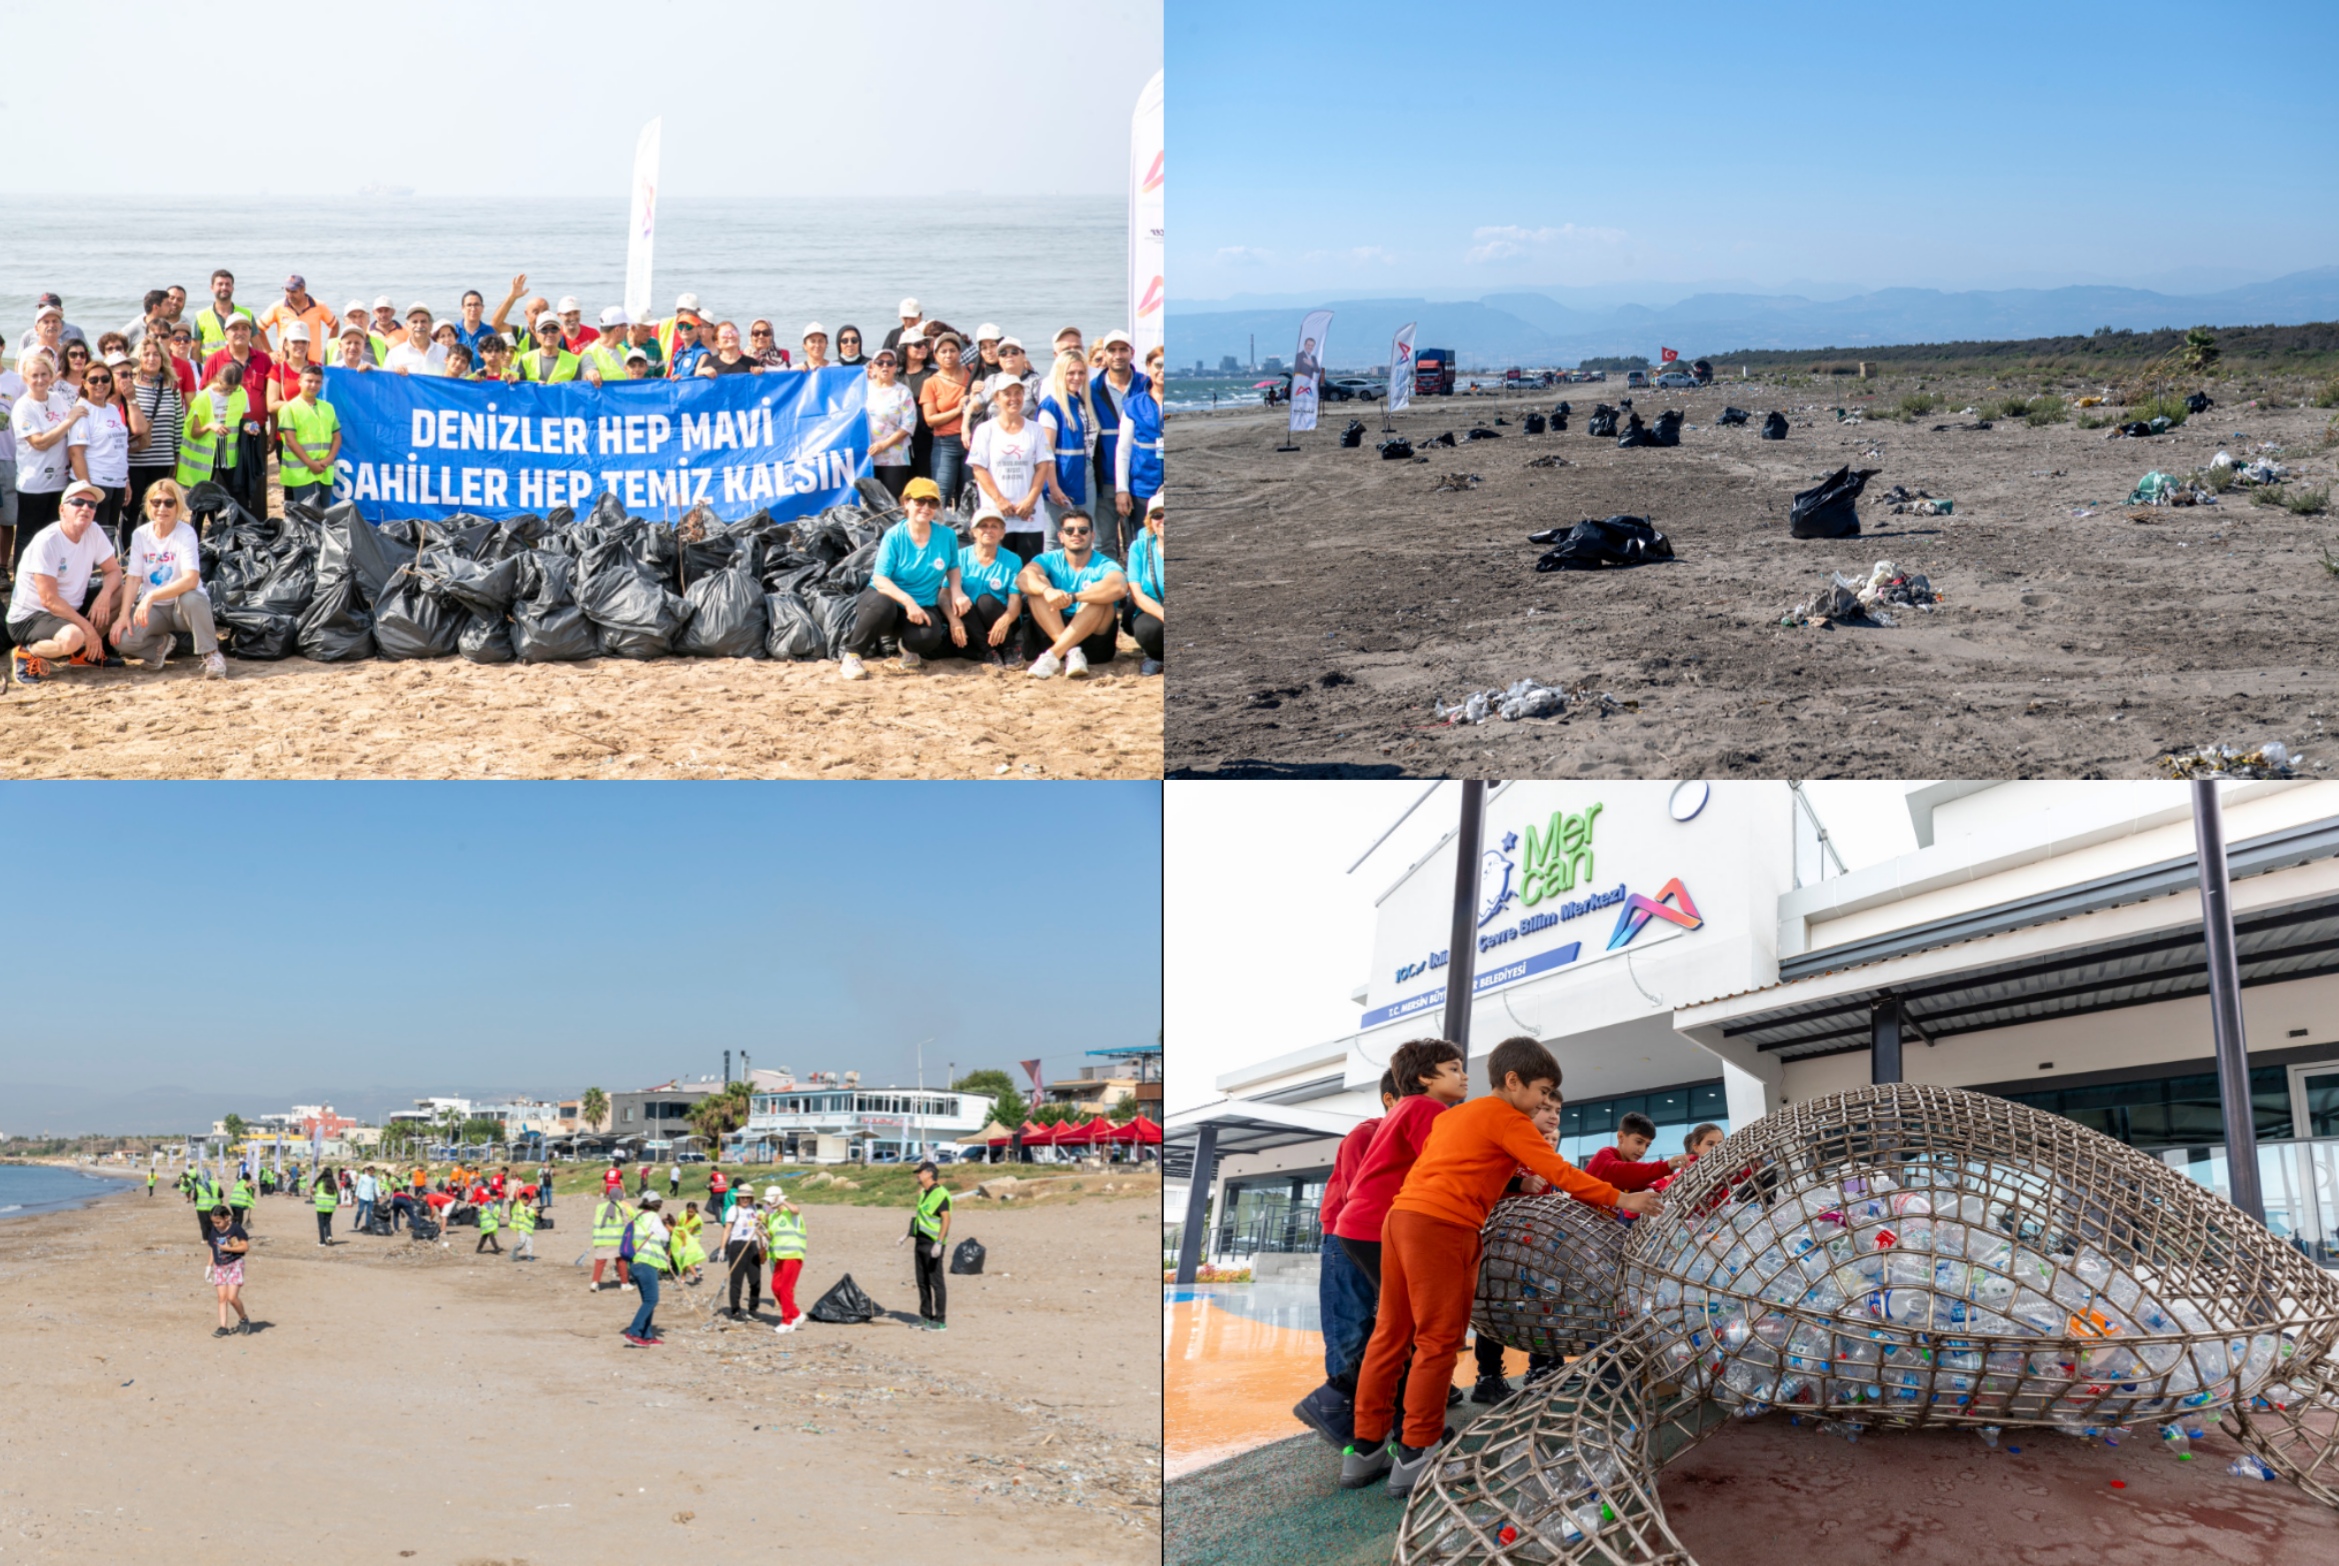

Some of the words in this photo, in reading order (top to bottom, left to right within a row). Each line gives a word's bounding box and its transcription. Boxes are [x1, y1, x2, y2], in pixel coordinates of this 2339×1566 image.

[411, 401, 589, 455] DENİZLER
[598, 413, 671, 454] HEP
[681, 396, 774, 453] MAVİ
[333, 452, 508, 507] SAHİLLER
[519, 468, 593, 508] HEP
[600, 456, 713, 508] TEMİZ
[723, 446, 856, 501] KALSIN
[1523, 802, 1603, 872] Mer
[1519, 845, 1594, 906] can
[1478, 926, 1518, 953] Çevre
[1519, 913, 1558, 936] Bilim
[1560, 883, 1626, 922] Merkezi
[1479, 961, 1527, 988] BELEDİYESİ
